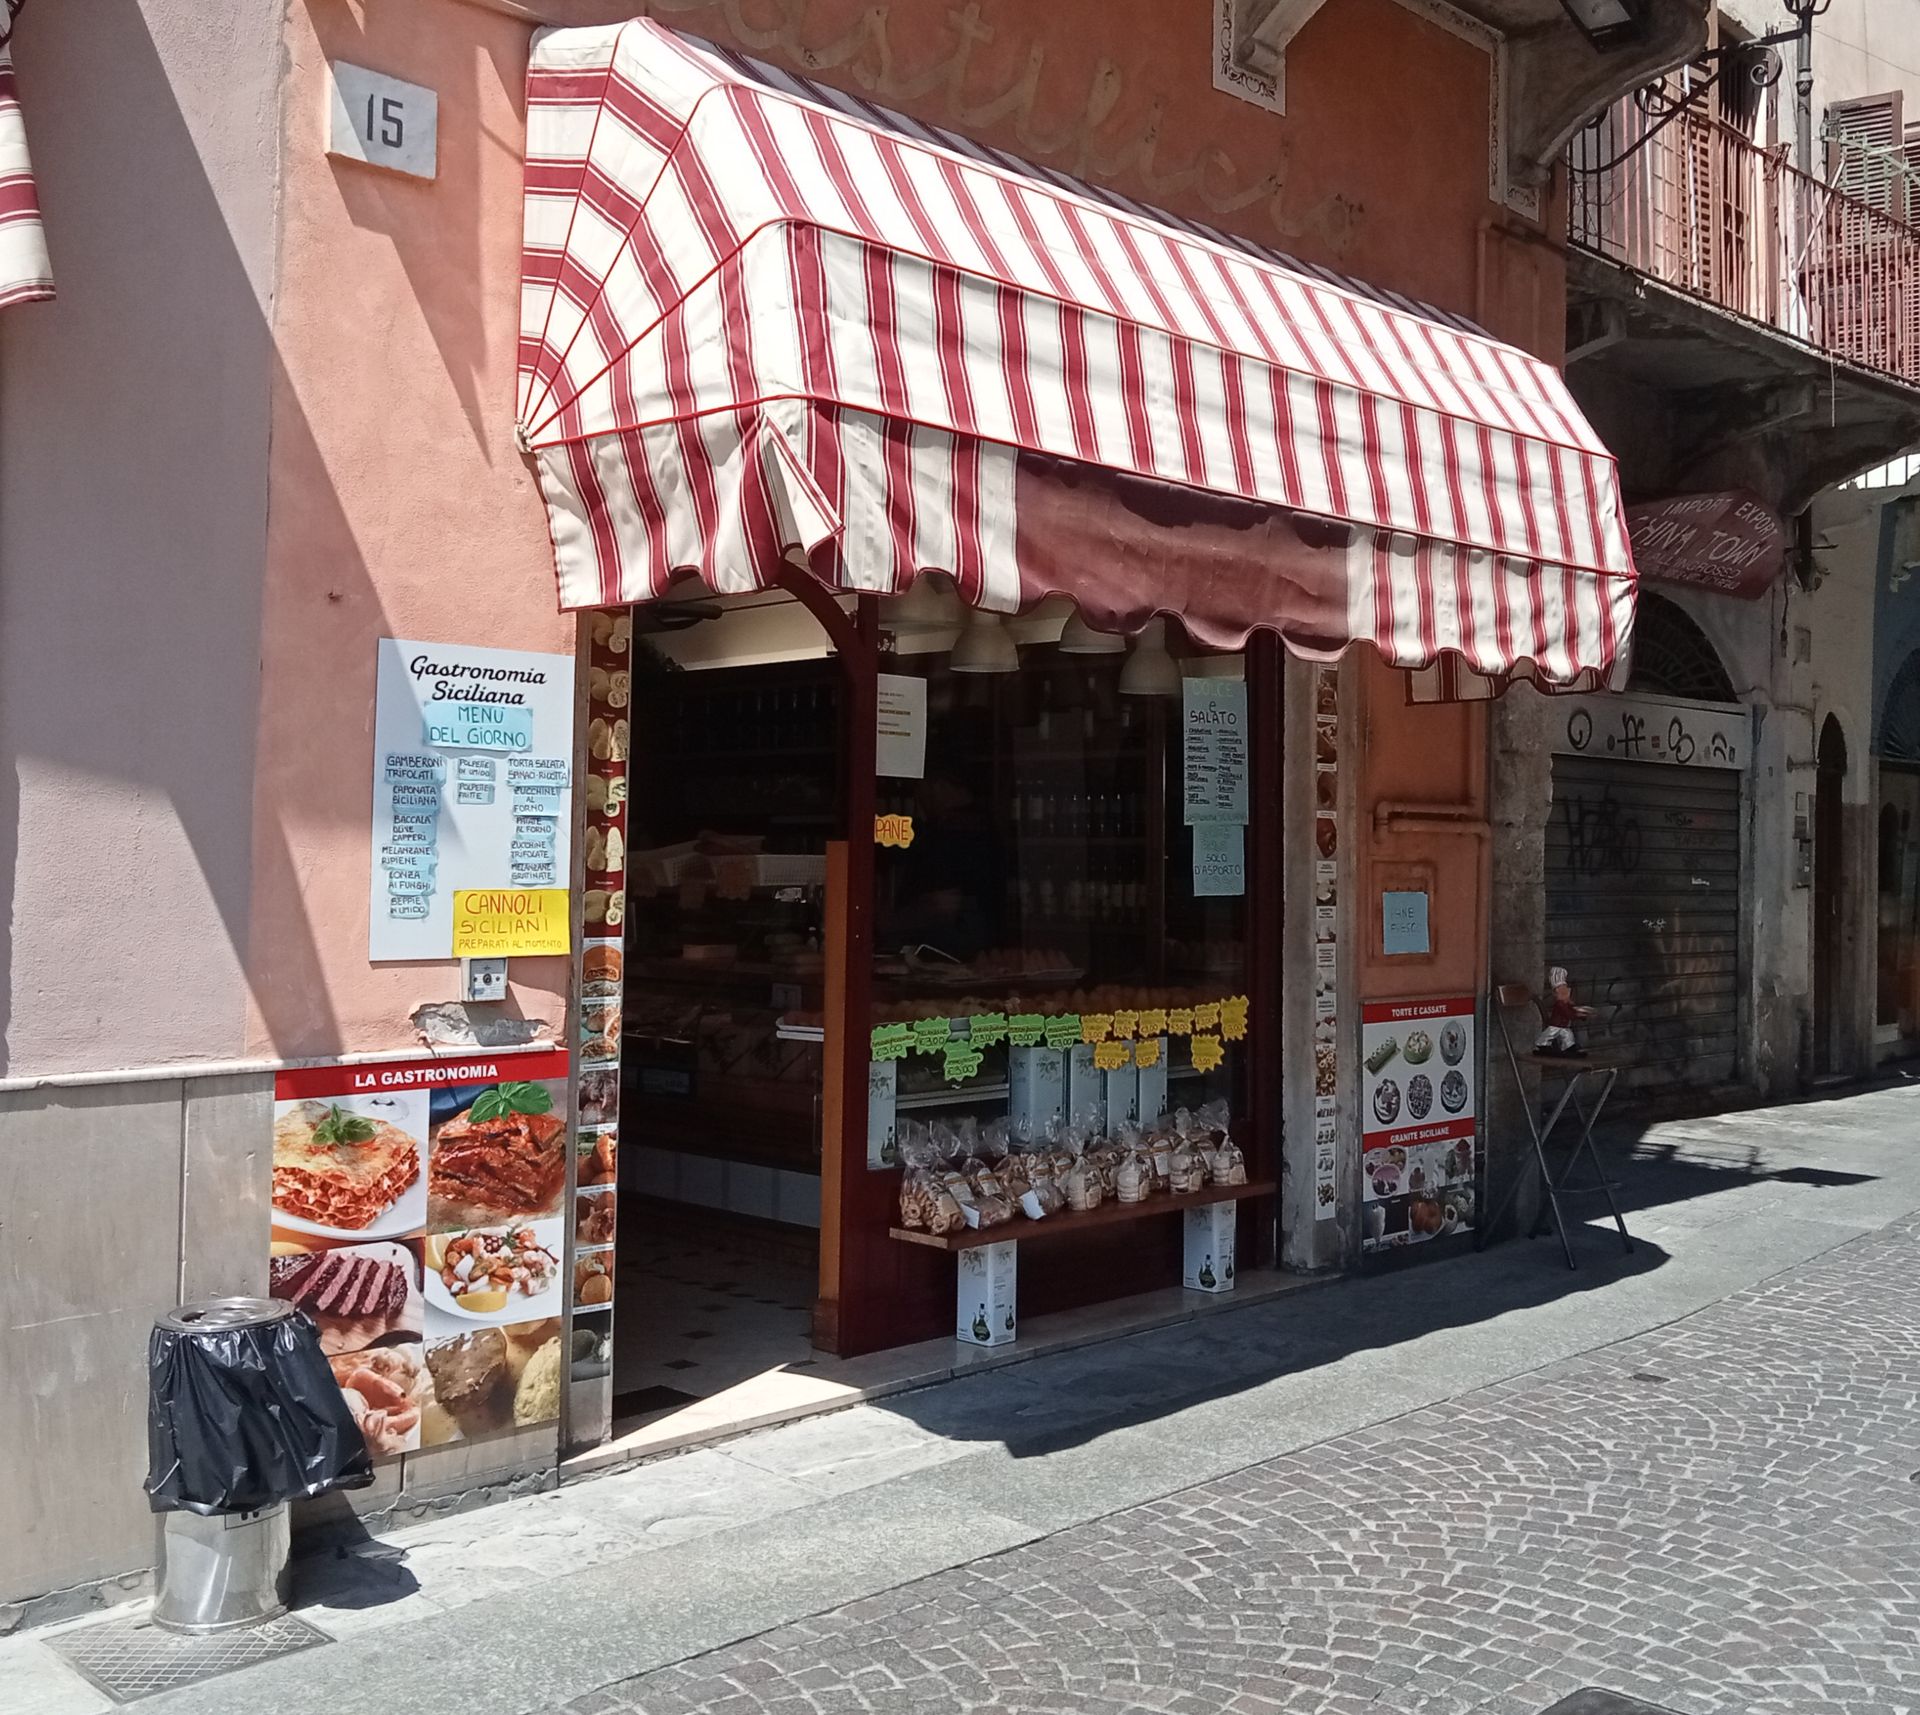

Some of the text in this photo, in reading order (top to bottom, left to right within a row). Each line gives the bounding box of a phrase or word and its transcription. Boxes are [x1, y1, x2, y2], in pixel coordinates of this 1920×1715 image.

[367, 94, 404, 148] 15
[1734, 501, 1778, 542] EXPORT
[1695, 530, 1773, 568] TOWN
[410, 655, 548, 685] Gastronomia
[432, 680, 526, 705] Siciliana
[1190, 711, 1237, 725] SALATO
[430, 726, 460, 744] DEL
[508, 758, 566, 769] TORTA SALATA
[514, 803, 544, 812] FORNO
[526, 825, 552, 833] FORNO
[875, 819, 910, 841] PANE
[381, 846, 431, 856] MELANZANE
[1205, 853, 1227, 863] SOLO
[1194, 864, 1242, 876] D'ASPORTO
[400, 881, 431, 890] FUNGHI
[465, 893, 542, 915] CANNOLI
[459, 917, 548, 934] SICILIANI
[512, 940, 523, 949] AL
[1392, 1004, 1447, 1017] TORTE E CASSATE
[355, 1064, 498, 1087] LA GASTRONOMIA
[1391, 1126, 1450, 1143] GRANITE SICILIANE
